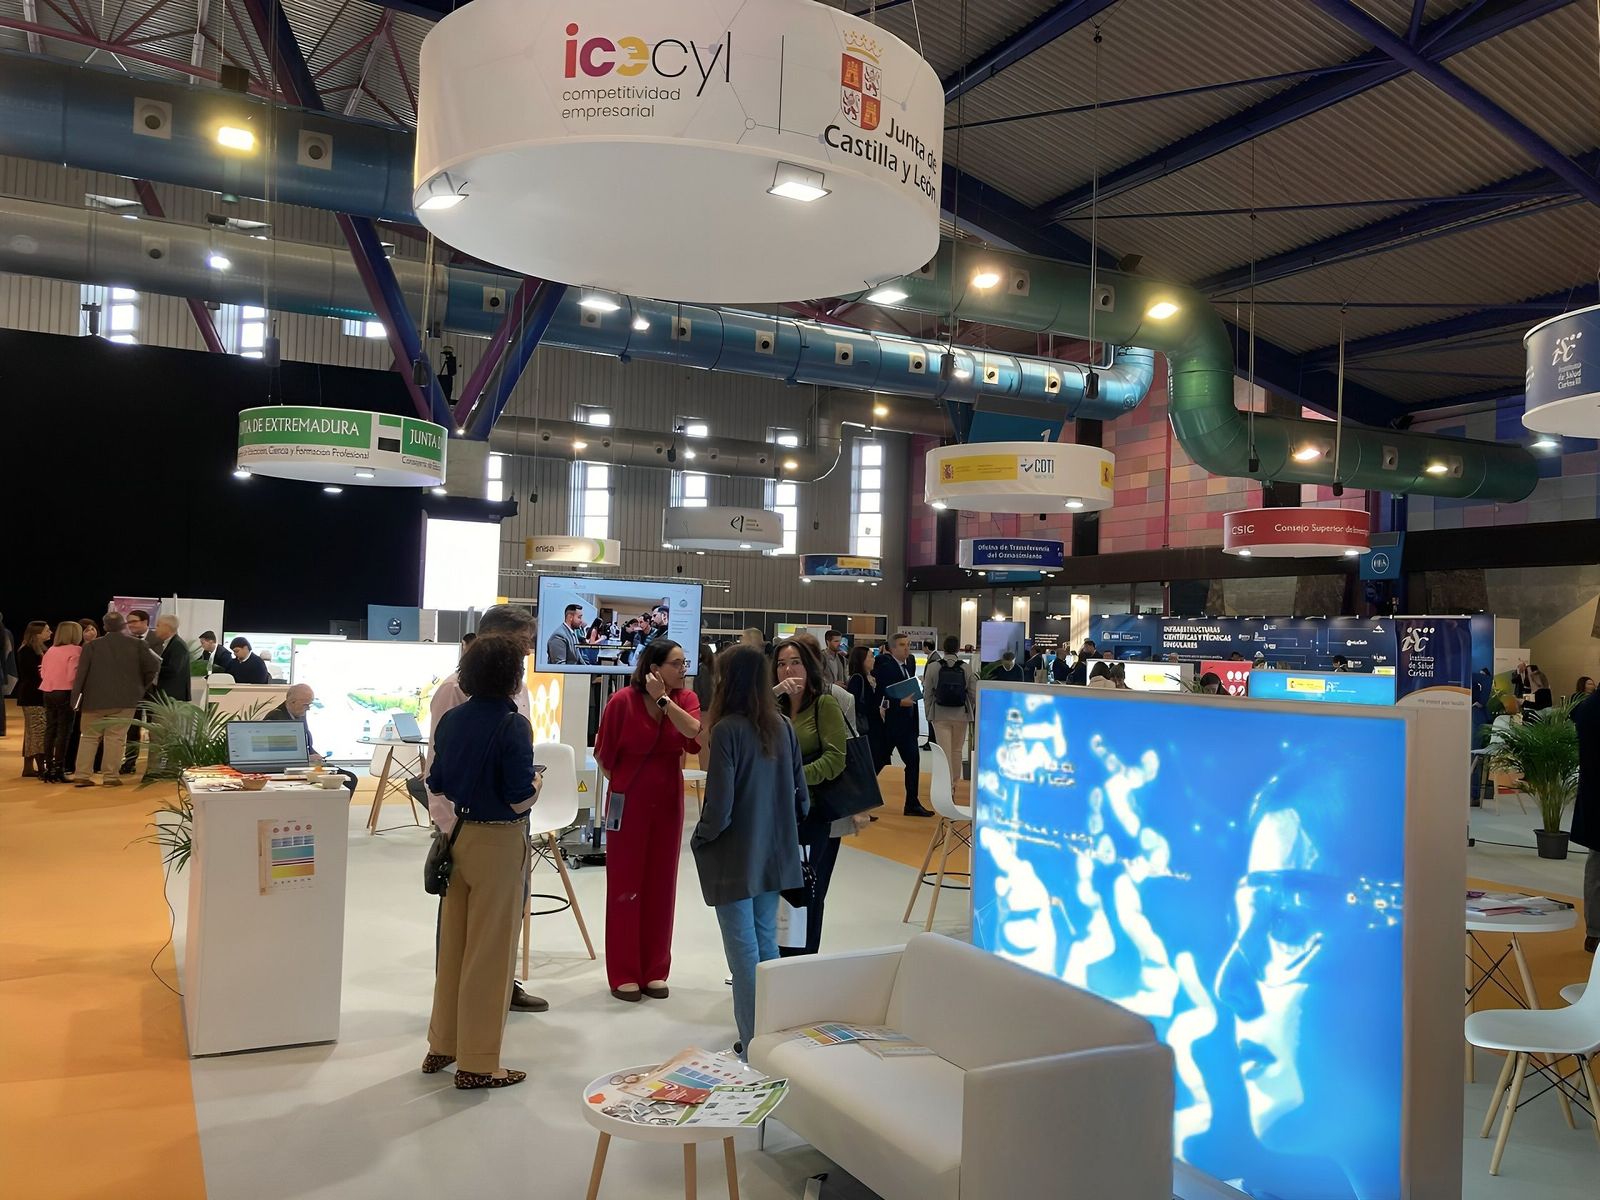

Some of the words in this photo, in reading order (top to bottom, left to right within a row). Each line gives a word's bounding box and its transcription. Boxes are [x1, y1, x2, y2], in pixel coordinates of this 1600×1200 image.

[562, 86, 681, 102] competitividad
[561, 104, 655, 121] empresarial
[885, 117, 926, 161] Junta
[824, 124, 898, 172] Castilla
[901, 160, 911, 184] y
[914, 164, 936, 203] León
[253, 418, 264, 433] DE
[265, 417, 360, 436] EXTREMADURA
[409, 428, 437, 449] JUNTA
[1232, 524, 1255, 535] CSIC
[1274, 523, 1310, 533] Consejo
[1311, 523, 1344, 533] Superior
